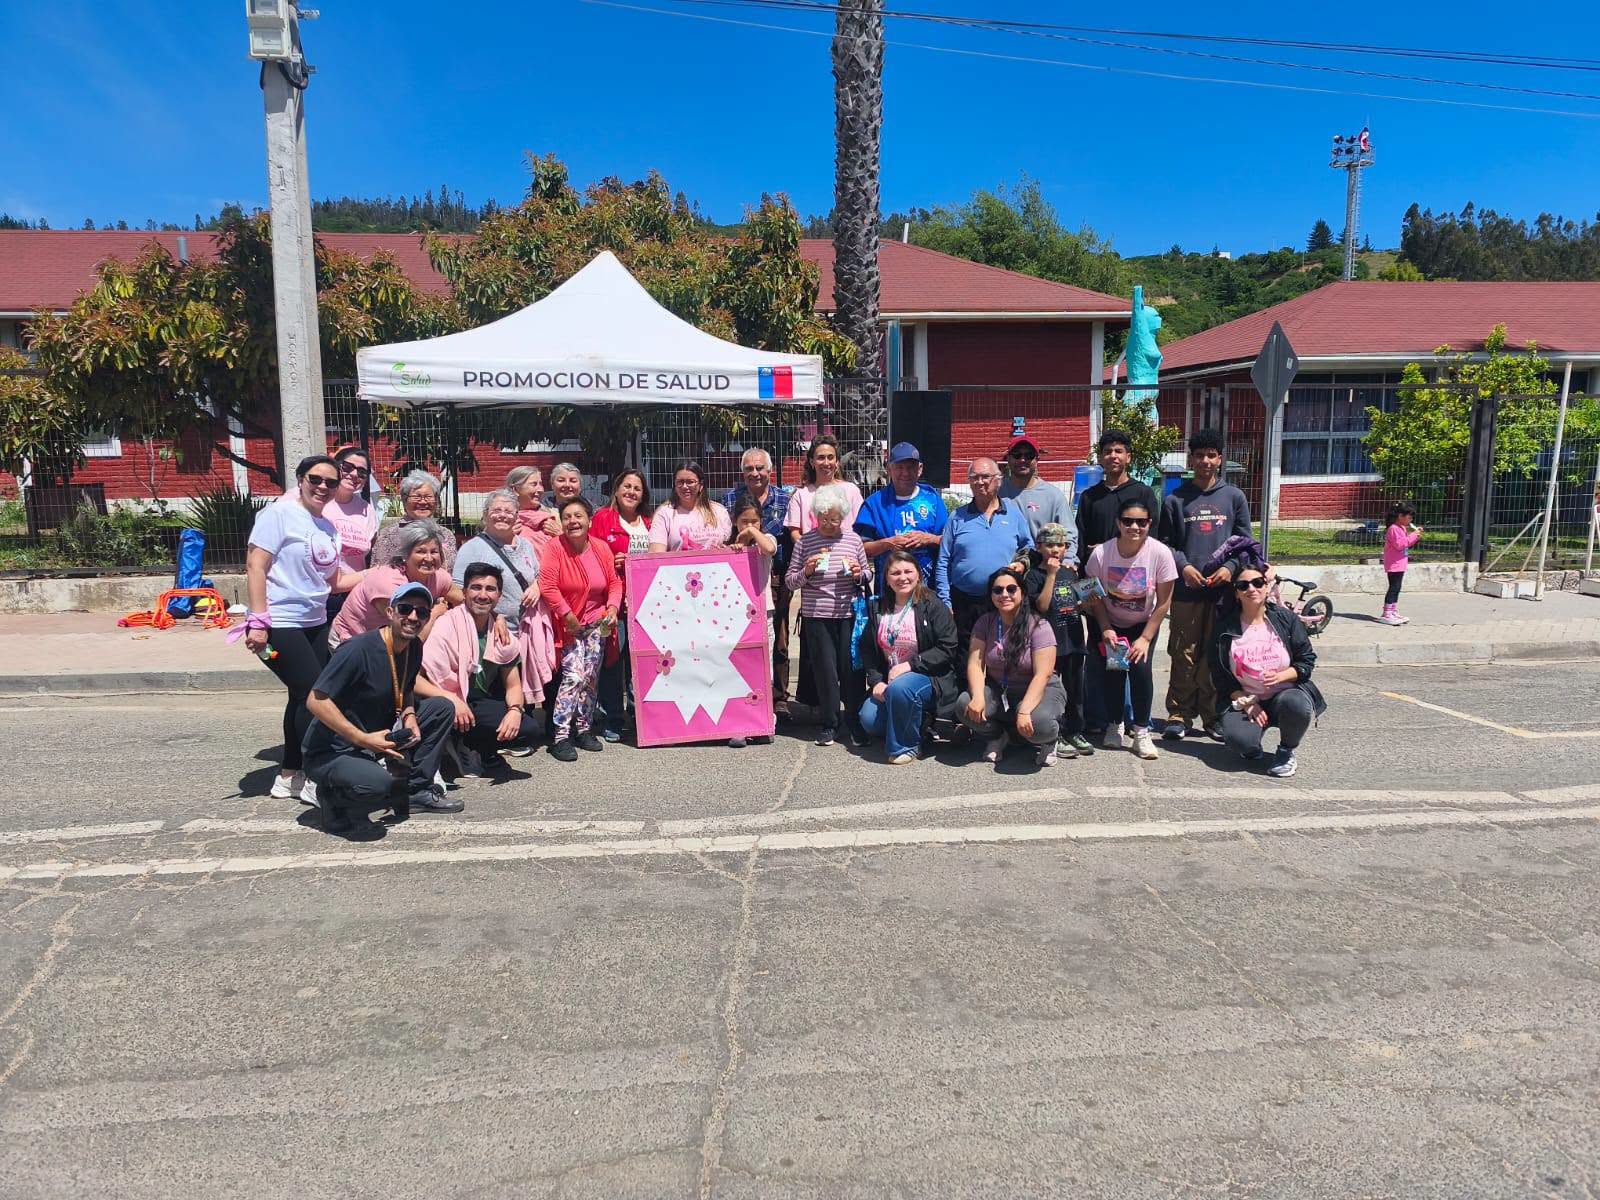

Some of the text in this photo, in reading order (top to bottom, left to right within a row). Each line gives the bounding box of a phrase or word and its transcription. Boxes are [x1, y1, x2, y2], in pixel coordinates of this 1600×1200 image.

[400, 373, 432, 386] Salud
[463, 371, 731, 390] PROMOCION DE SALUD
